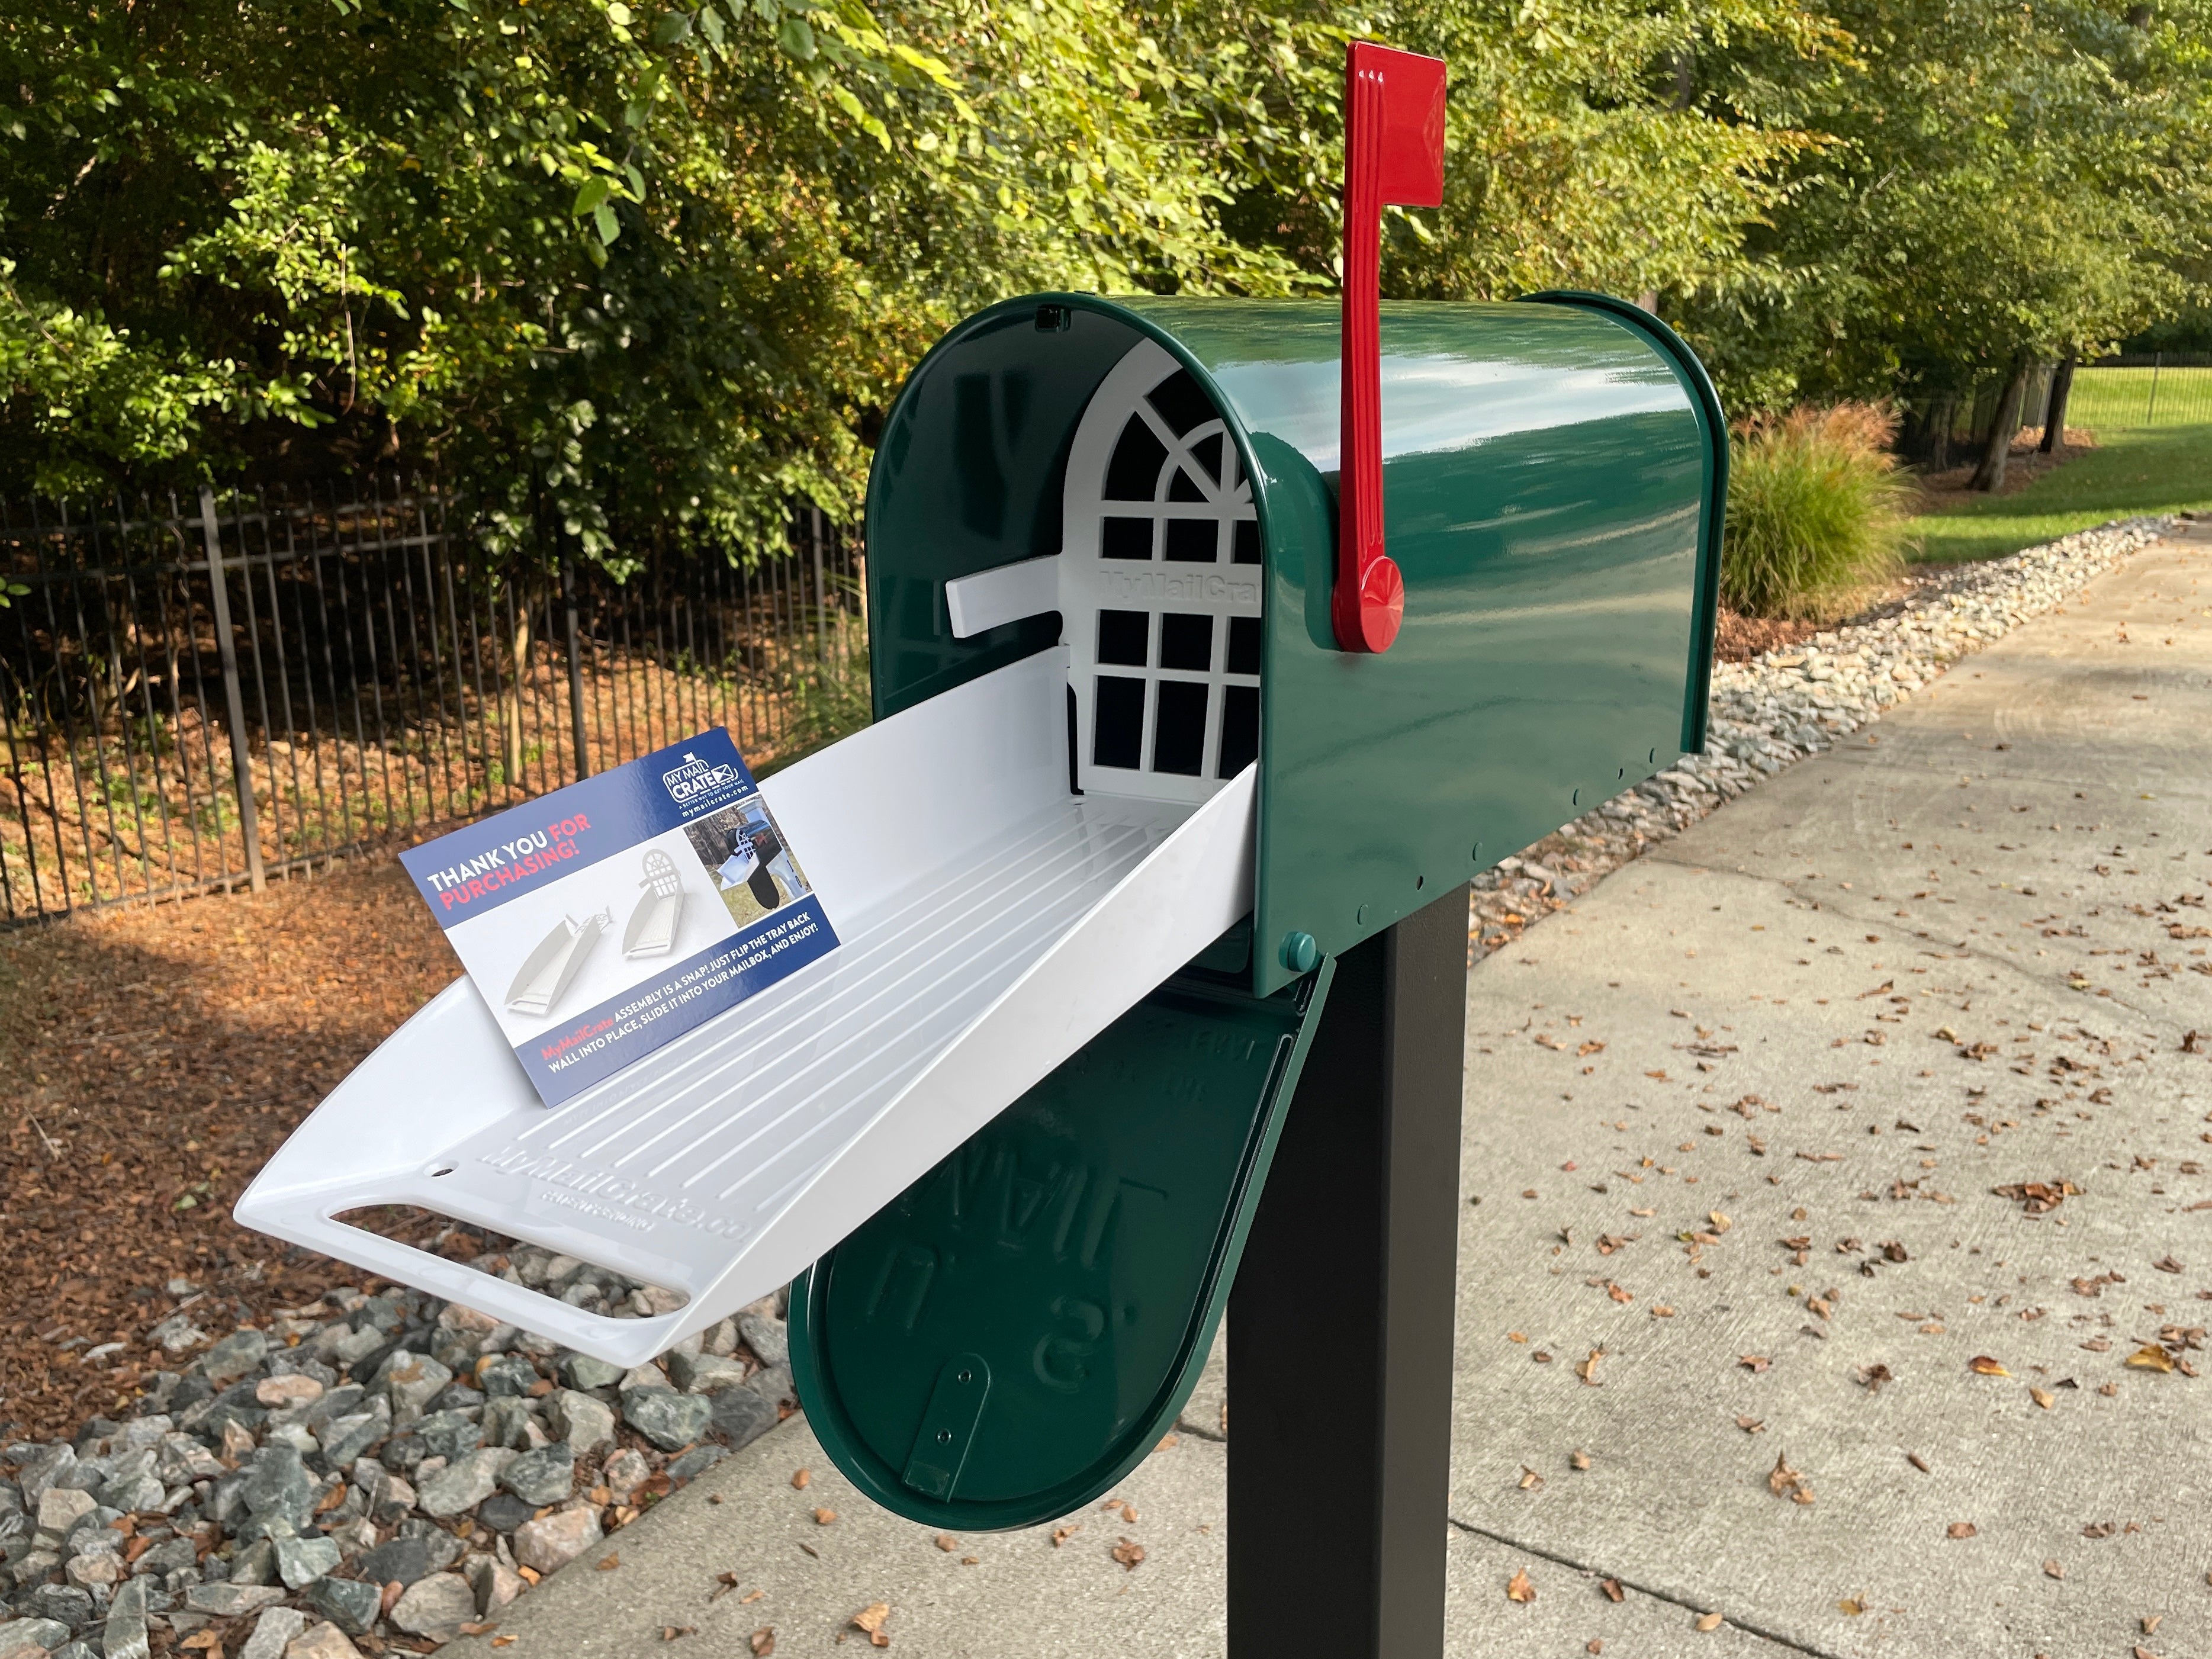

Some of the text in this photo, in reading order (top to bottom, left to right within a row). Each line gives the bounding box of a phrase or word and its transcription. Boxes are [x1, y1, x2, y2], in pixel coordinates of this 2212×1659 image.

[1099, 571, 1260, 604] MyMailCra
[666, 762, 709, 786] MY MAIL
[673, 772, 716, 799] CRATE
[681, 785, 748, 818] mymailcrate.com
[683, 799, 698, 808] BETTER
[427, 814, 591, 892] THANK YOU FOR
[439, 839, 580, 910] PURCHASING!
[541, 911, 811, 1060] MyMailCrate ASSEMBLY IS A SNAP! JUST FLIP THE TRAY BACK
[548, 922, 819, 1073] WALL INTO PLACE, SLIDE IT INTO YOUR MAILBOX, AND ENJOY!
[475, 1146, 754, 1243] MyMailCrate.co
